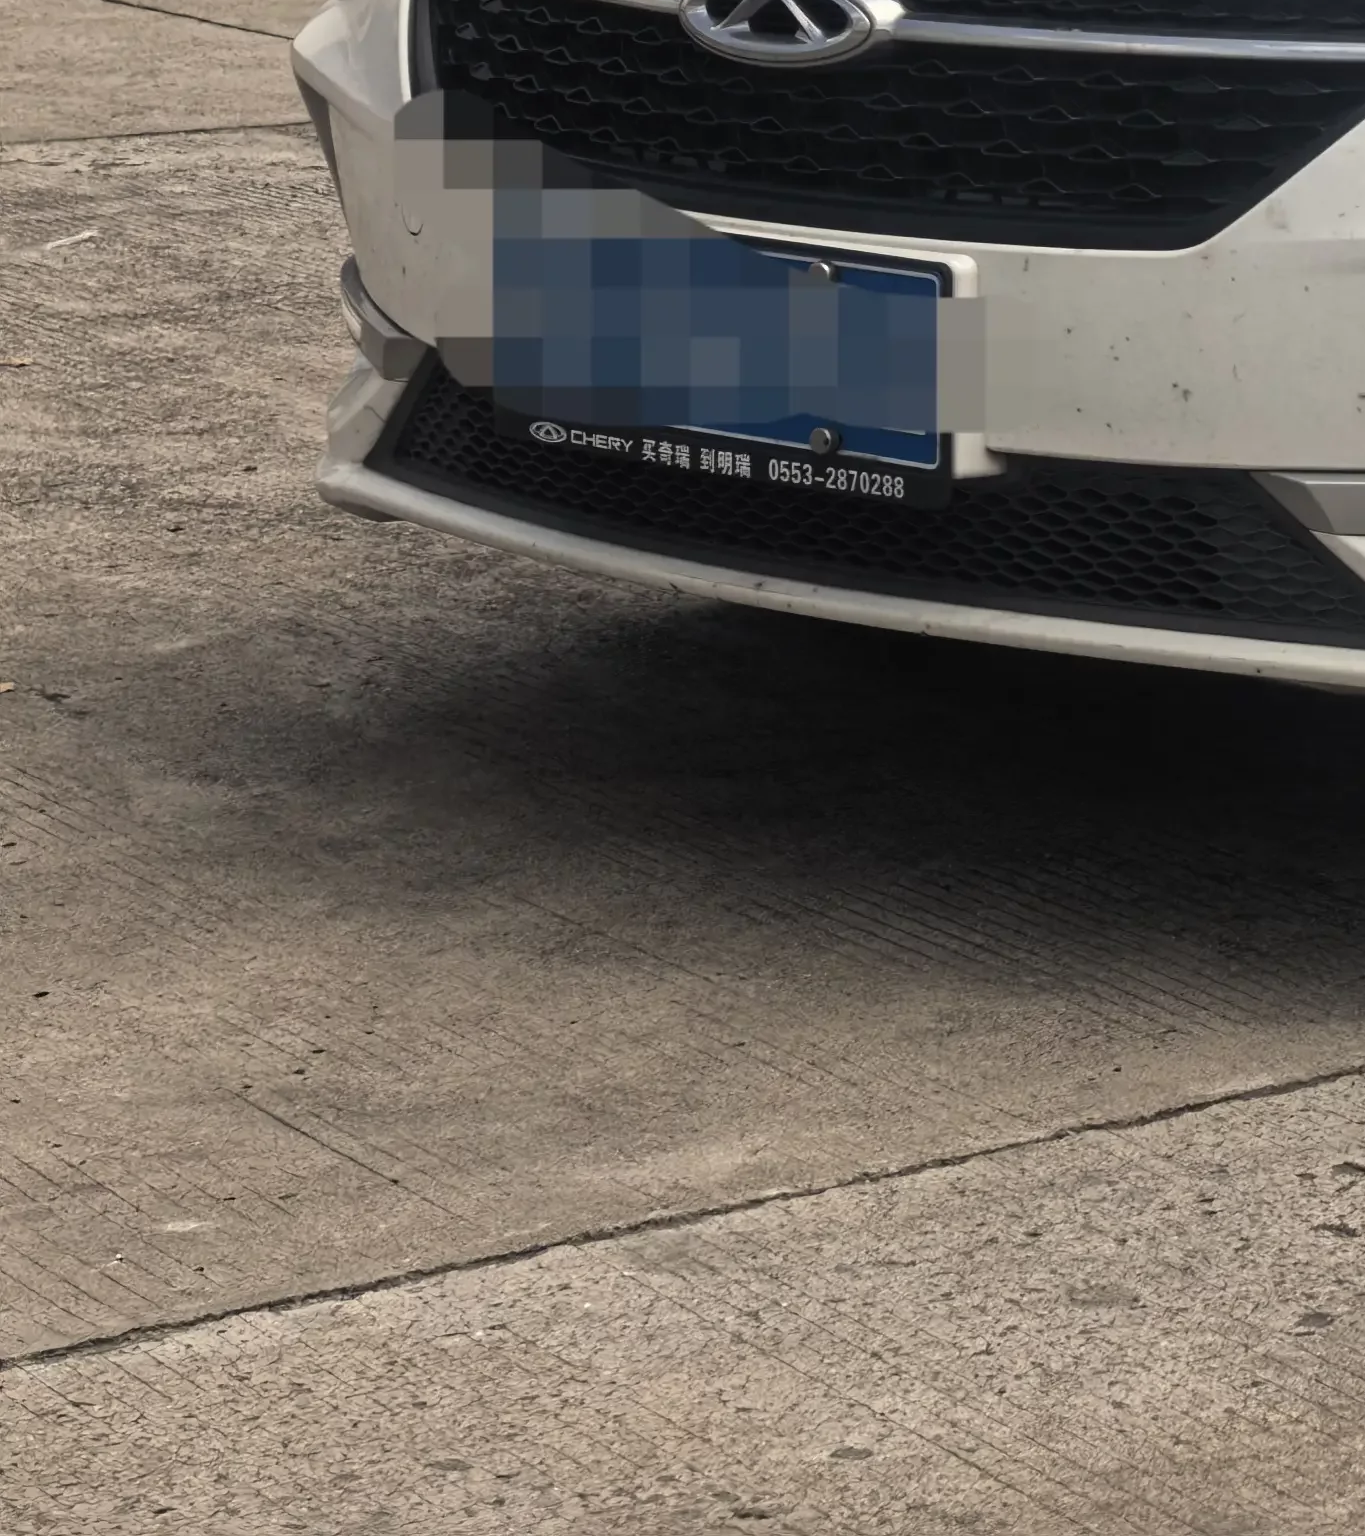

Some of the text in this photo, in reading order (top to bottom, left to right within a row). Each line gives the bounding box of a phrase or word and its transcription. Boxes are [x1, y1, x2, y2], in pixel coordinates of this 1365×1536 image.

[570, 429, 905, 499] CHERY 买奇瑞 到明瑞 0553-2870288
